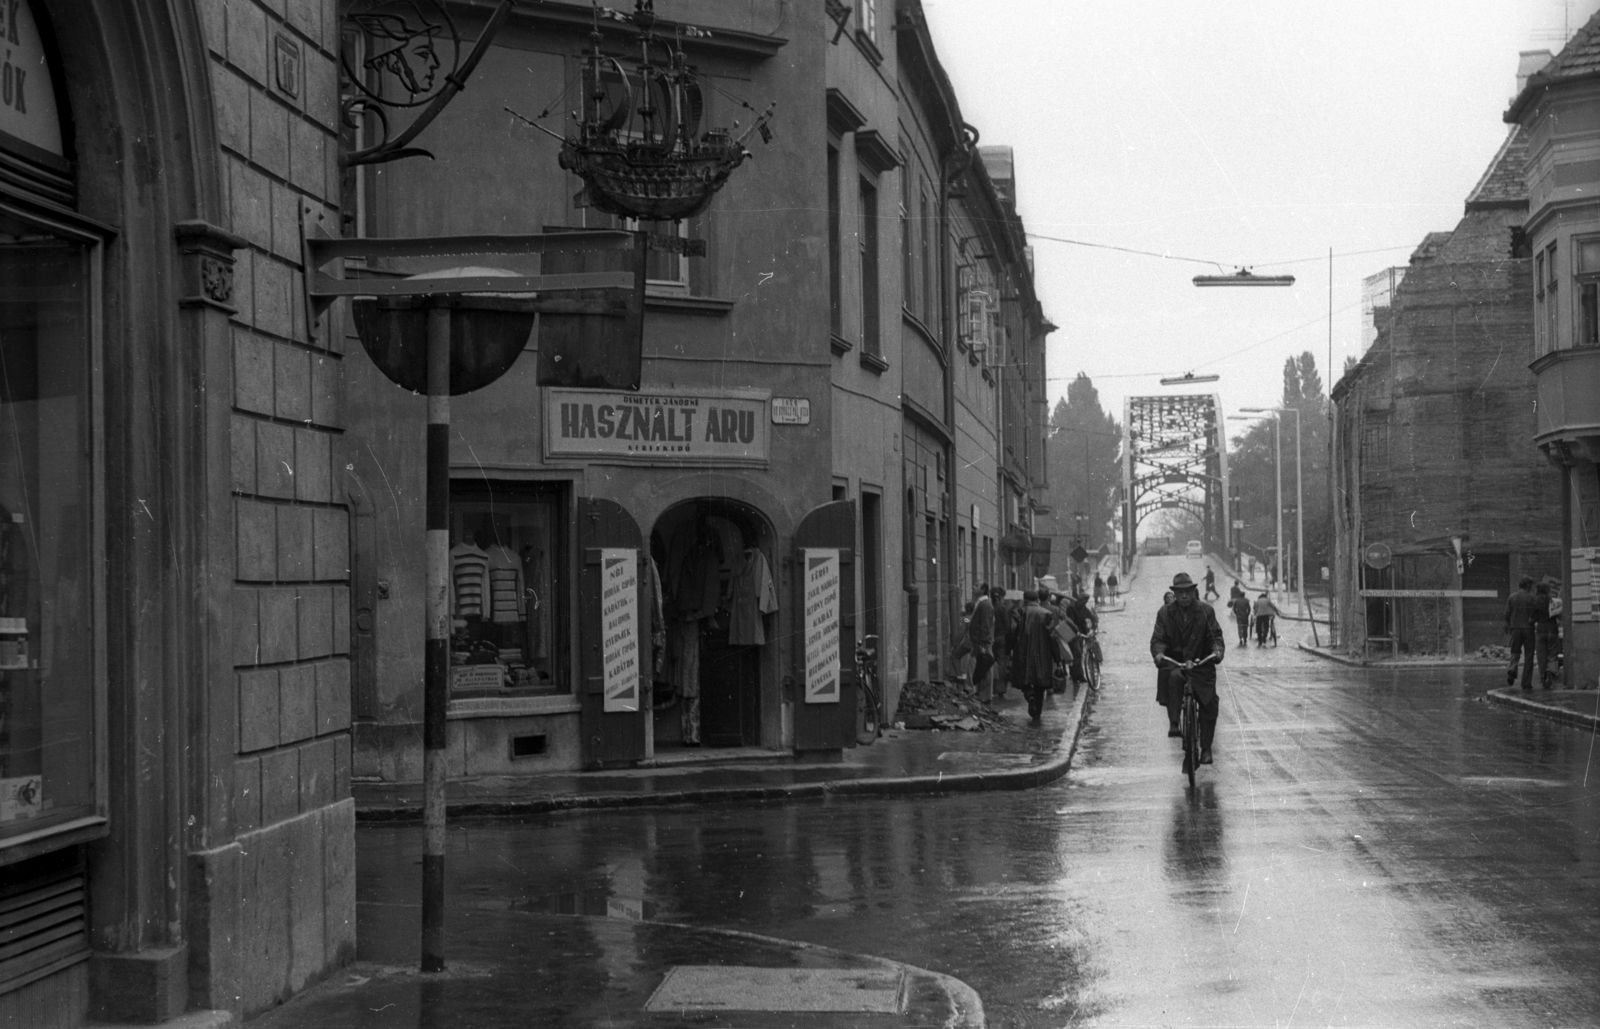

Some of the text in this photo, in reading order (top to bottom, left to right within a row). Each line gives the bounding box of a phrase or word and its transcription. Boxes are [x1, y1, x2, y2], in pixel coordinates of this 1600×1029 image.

[623, 396, 661, 406] DEMETER
[560, 402, 756, 444] HASZNÁLT ÁRU
[609, 565, 624, 580] NŐI
[811, 565, 829, 583] FÉRFI
[603, 597, 628, 617] KABÁTOK
[812, 608, 833, 628] KABÁT
[605, 627, 632, 649] GYERMEK
[608, 657, 635, 680] KABÁTOK
